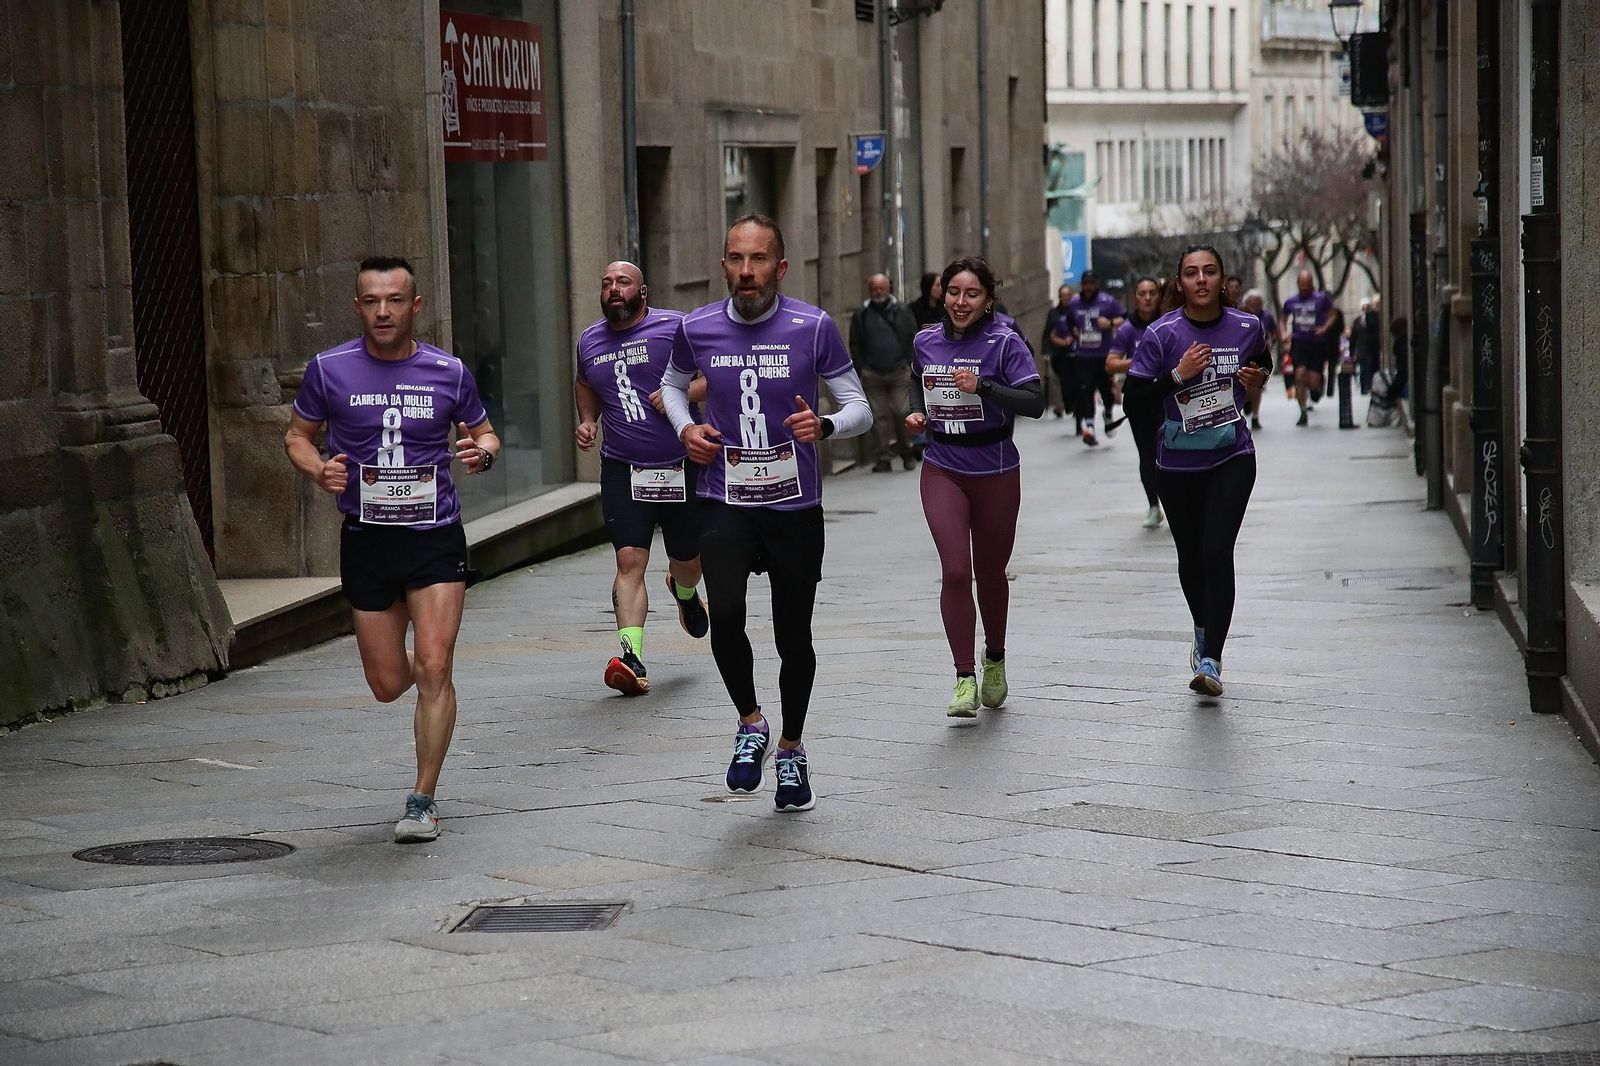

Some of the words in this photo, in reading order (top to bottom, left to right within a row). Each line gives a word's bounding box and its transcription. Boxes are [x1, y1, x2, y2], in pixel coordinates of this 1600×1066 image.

[462, 32, 541, 90] SANTORUM
[594, 352, 617, 366] CARREIRA
[618, 350, 625, 359] DA
[627, 346, 647, 357] MULLER
[627, 354, 649, 365] OURENSE
[711, 355, 744, 367] CARREIRA
[747, 355, 757, 366] DA
[760, 355, 788, 366] MULLER
[1218, 355, 1239, 364] MULLER
[759, 366, 790, 378] OURENSE
[924, 365, 946, 373] CARREIRA
[350, 394, 388, 406] CARREIRA
[391, 394, 402, 406] DA
[404, 395, 432, 407] MULLER
[942, 391, 960, 399] 568
[1199, 396, 1218, 408] 255
[403, 407, 434, 419] OURENSE
[754, 466, 768, 477] 21
[387, 485, 412, 496] 368
